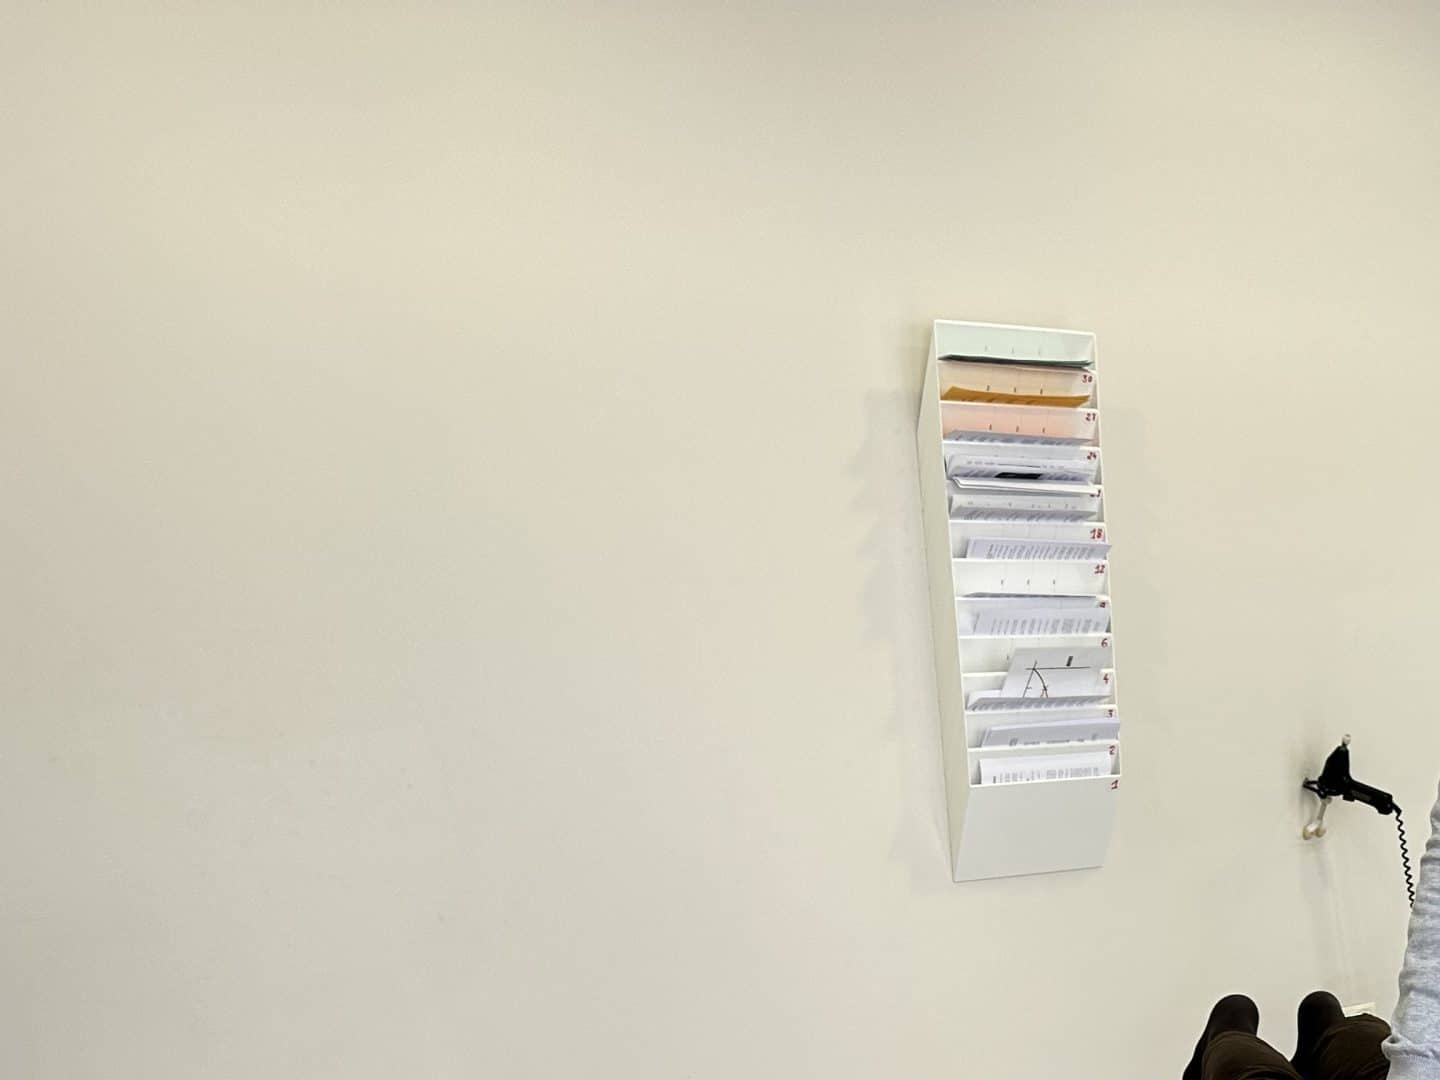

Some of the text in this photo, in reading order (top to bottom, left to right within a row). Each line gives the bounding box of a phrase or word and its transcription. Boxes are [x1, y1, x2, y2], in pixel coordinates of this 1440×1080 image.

[1090, 527, 1103, 540] 18
[1101, 638, 1109, 648] 6
[1103, 673, 1110, 685] 4
[1109, 744, 1117, 756] 2
[1110, 779, 1119, 790] 1
